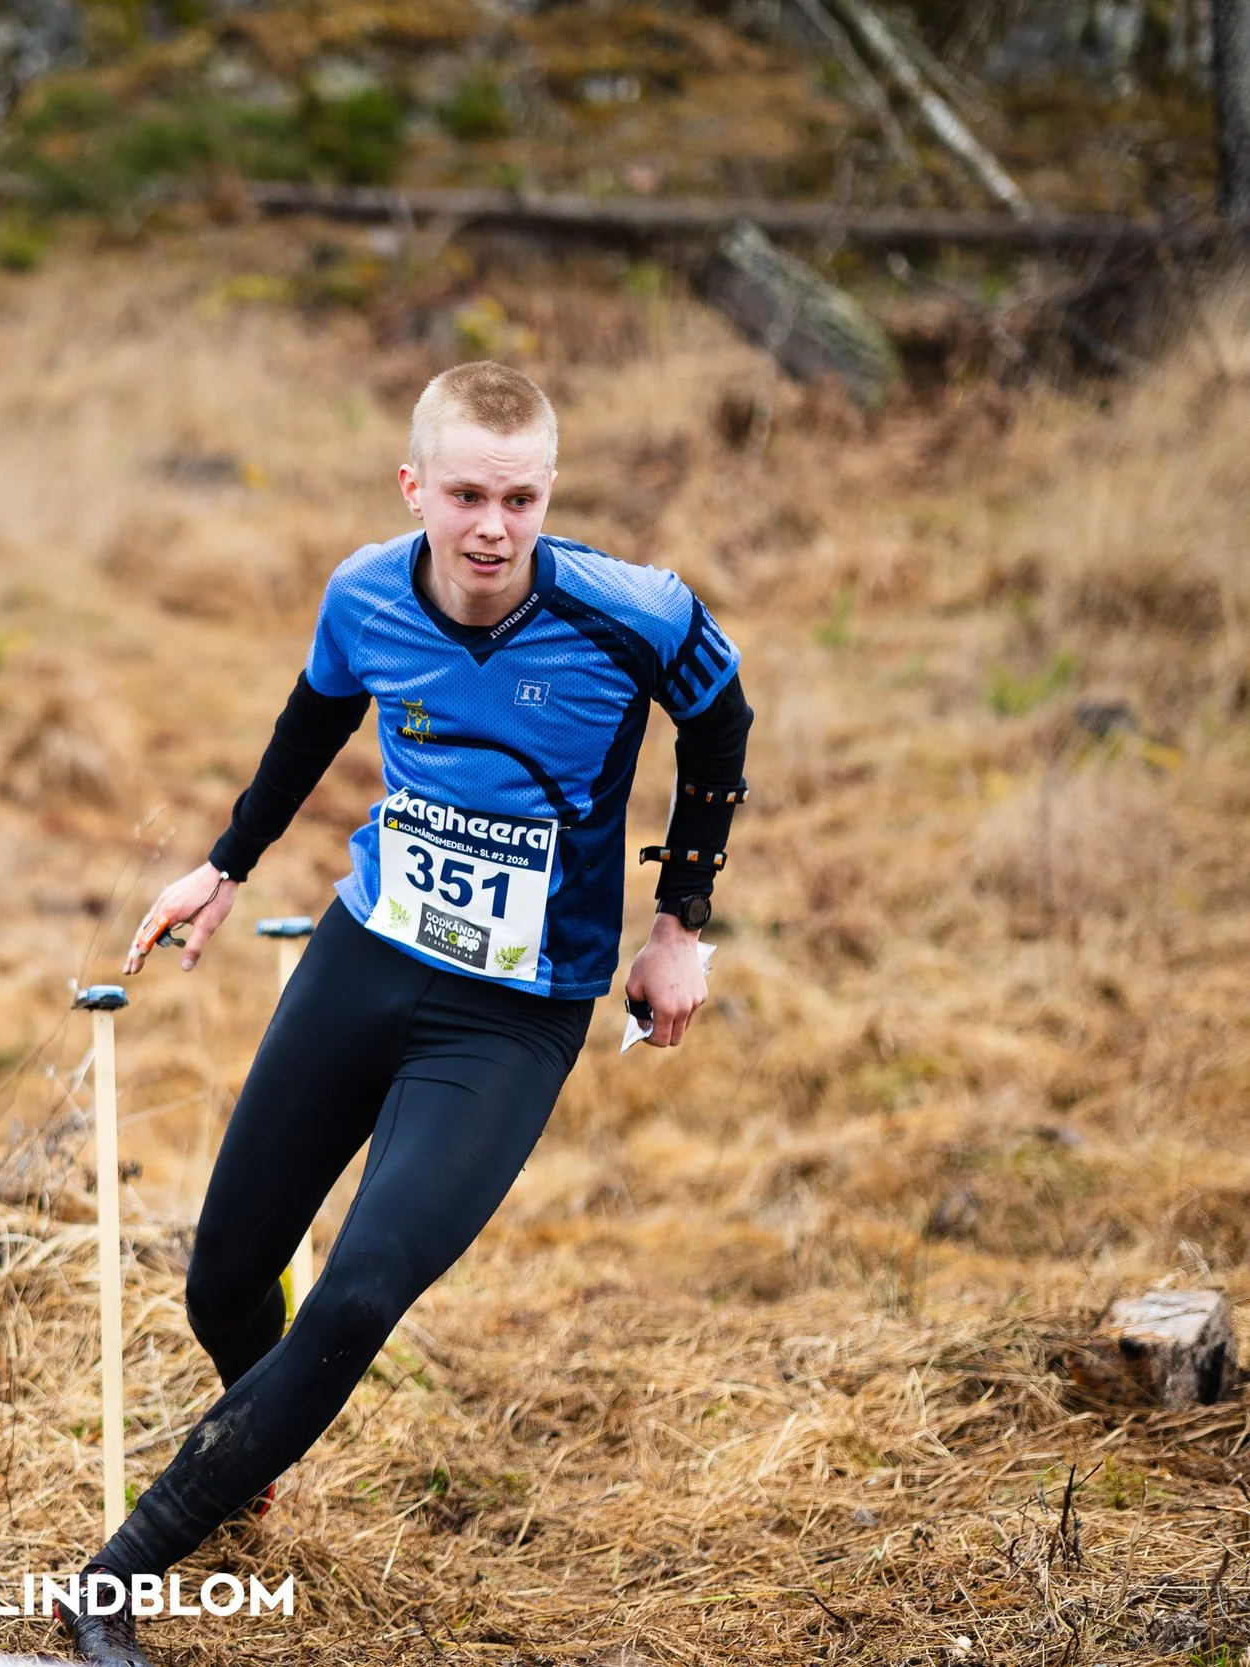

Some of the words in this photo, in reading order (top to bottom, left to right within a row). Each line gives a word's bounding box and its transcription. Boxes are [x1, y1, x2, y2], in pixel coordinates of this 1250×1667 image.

[490, 593, 539, 640] noname
[520, 684, 542, 701] n
[387, 788, 549, 850] bagheera
[399, 821, 473, 854] KOLMÅRDSMEDELN
[480, 849, 490, 859] SL
[491, 852, 504, 862] #2
[506, 854, 529, 866] 2026
[405, 844, 510, 919] 351
[426, 911, 482, 941] GODKÄNDA
[433, 940, 461, 955] SVERIGE
